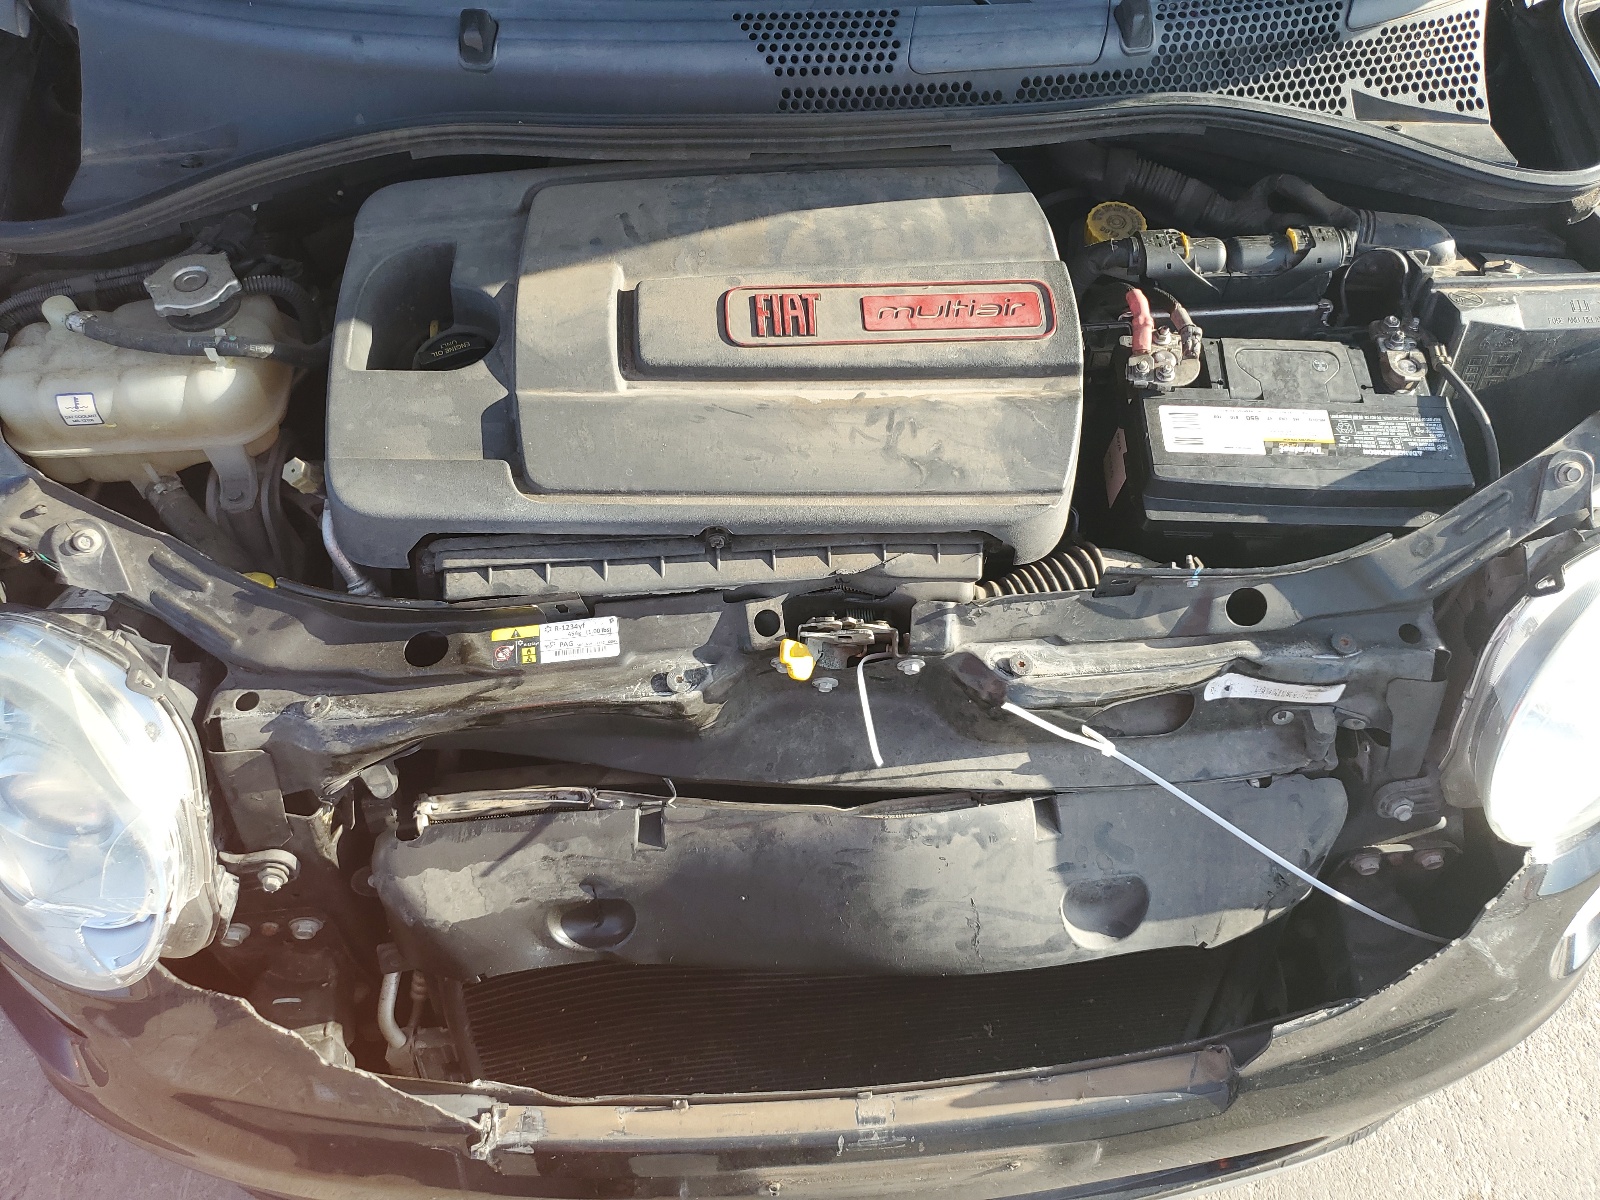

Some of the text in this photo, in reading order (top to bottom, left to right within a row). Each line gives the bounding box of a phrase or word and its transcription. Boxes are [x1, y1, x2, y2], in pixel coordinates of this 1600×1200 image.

[754, 293, 820, 337] FIAT
[877, 298, 1026, 320] multiair
[445, 341, 470, 354] ENGINE
[554, 622, 585, 632] R-1234yf
